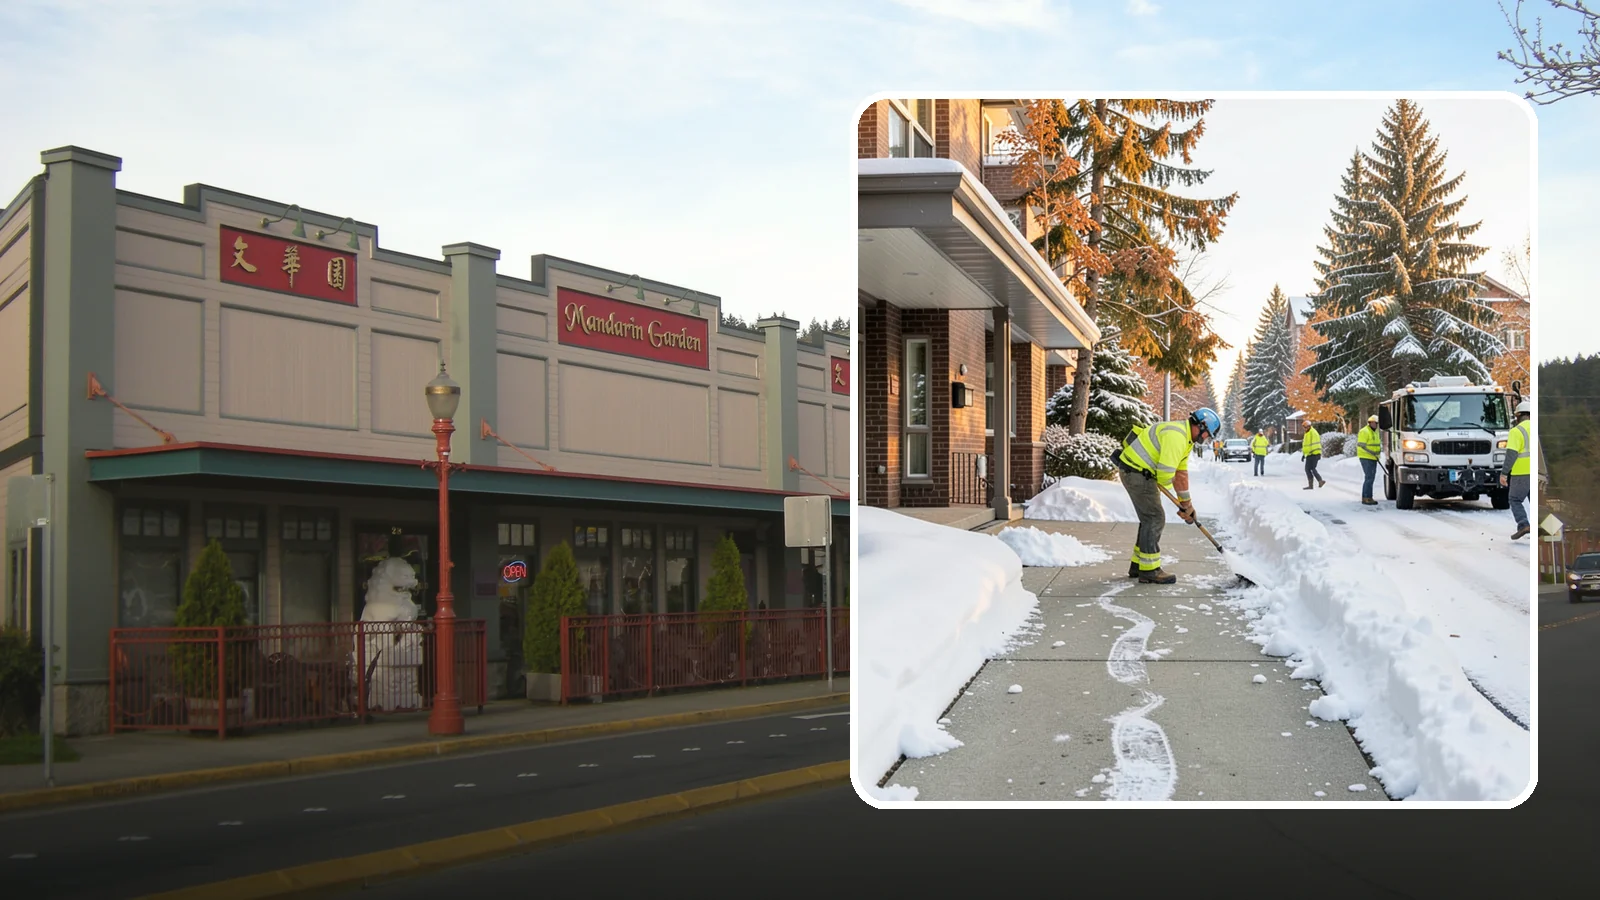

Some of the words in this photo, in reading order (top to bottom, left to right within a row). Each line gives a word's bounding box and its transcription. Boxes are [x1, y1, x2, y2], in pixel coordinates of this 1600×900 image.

[230, 236, 345, 290] 文華園
[564, 302, 644, 340] Mandarin
[648, 320, 701, 352] Garden
[503, 566, 527, 578] OPEN
